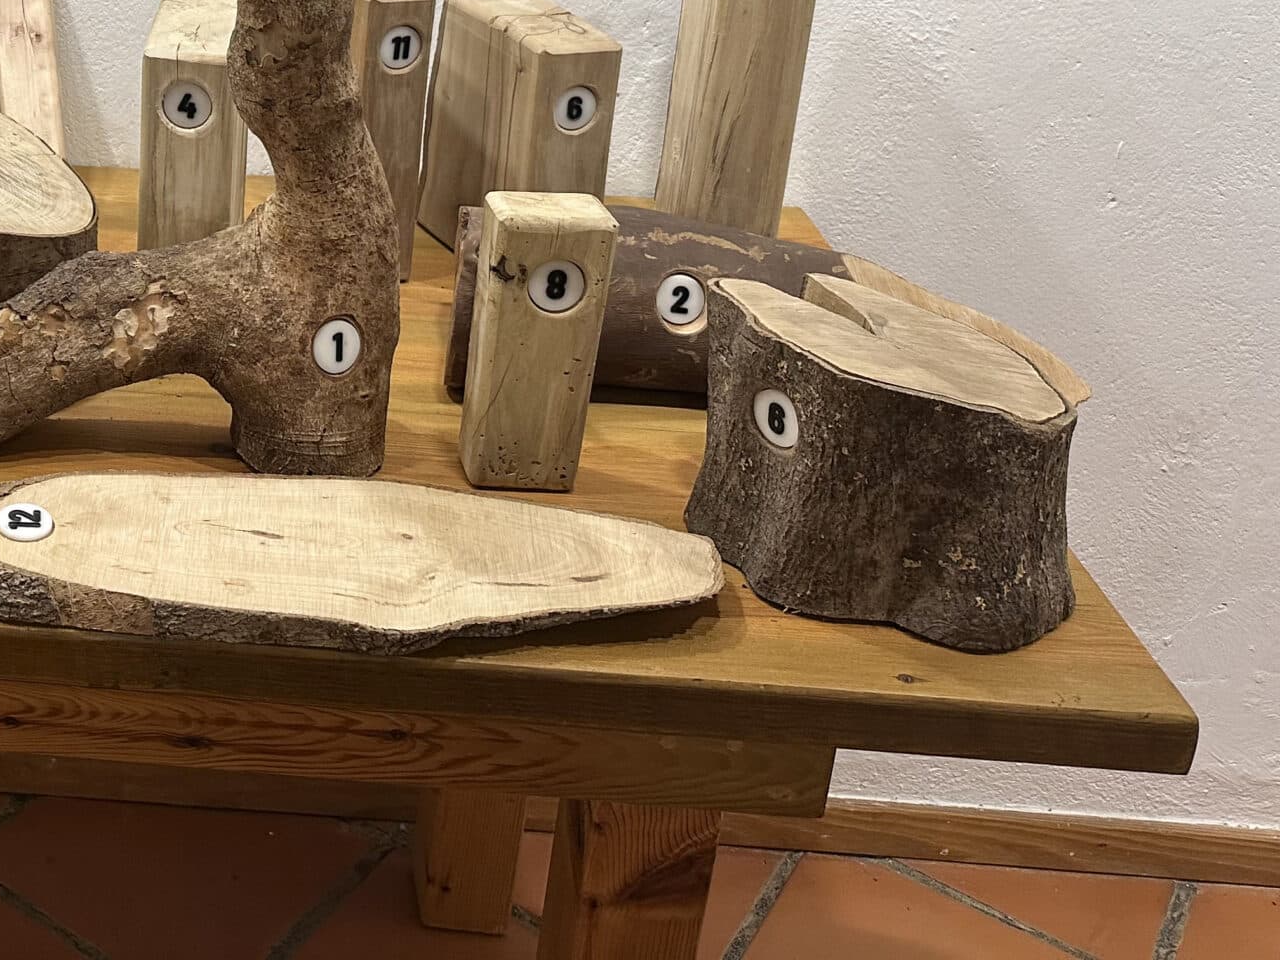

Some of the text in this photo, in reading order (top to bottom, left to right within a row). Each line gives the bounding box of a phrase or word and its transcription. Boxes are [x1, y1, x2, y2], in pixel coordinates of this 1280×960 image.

[391, 35, 410, 60] 11
[177, 94, 196, 119] 4
[566, 96, 582, 121] 6
[545, 271, 567, 299] 8
[670, 286, 689, 314] 2
[332, 332, 343, 362] 1
